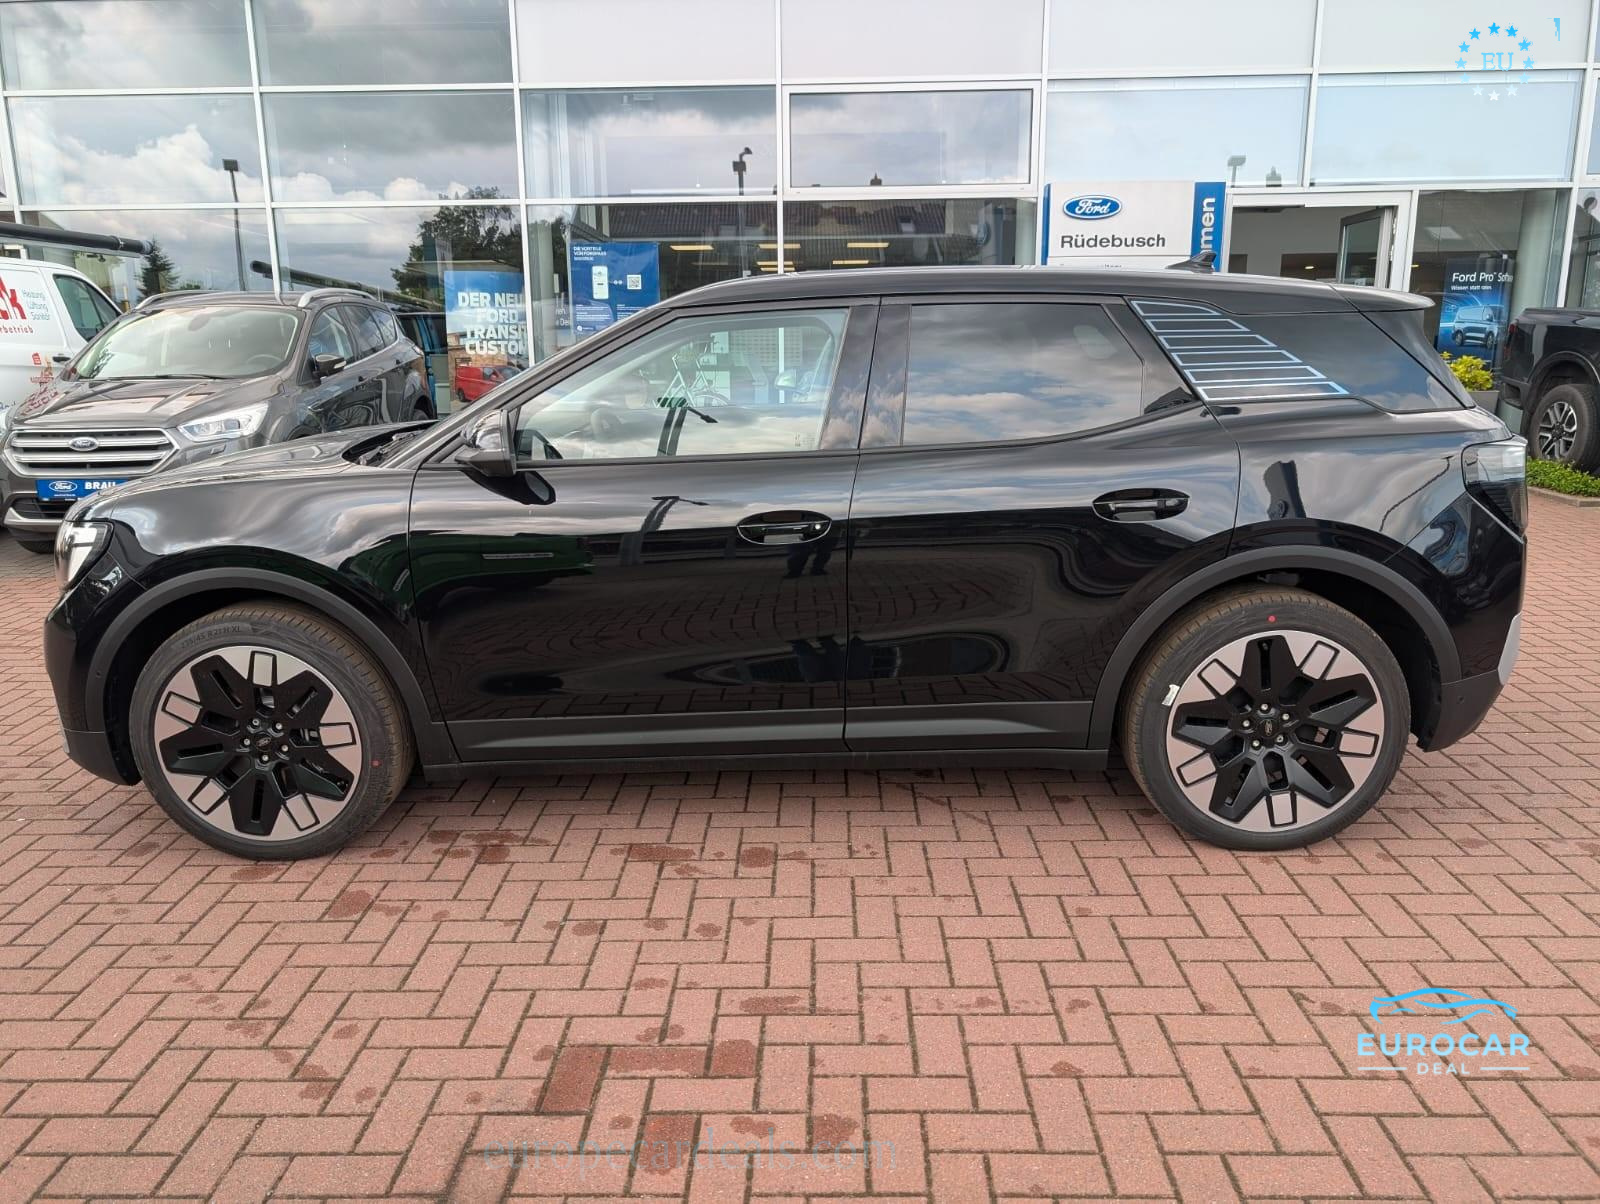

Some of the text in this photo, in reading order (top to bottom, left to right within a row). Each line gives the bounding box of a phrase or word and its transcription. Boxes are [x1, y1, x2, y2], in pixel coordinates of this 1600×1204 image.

[1200, 197, 1216, 252] men
[1061, 233, 1166, 249] Rüdebusch
[1452, 272, 1477, 282] Ford
[458, 291, 491, 308] DER
[476, 308, 519, 324] FORD
